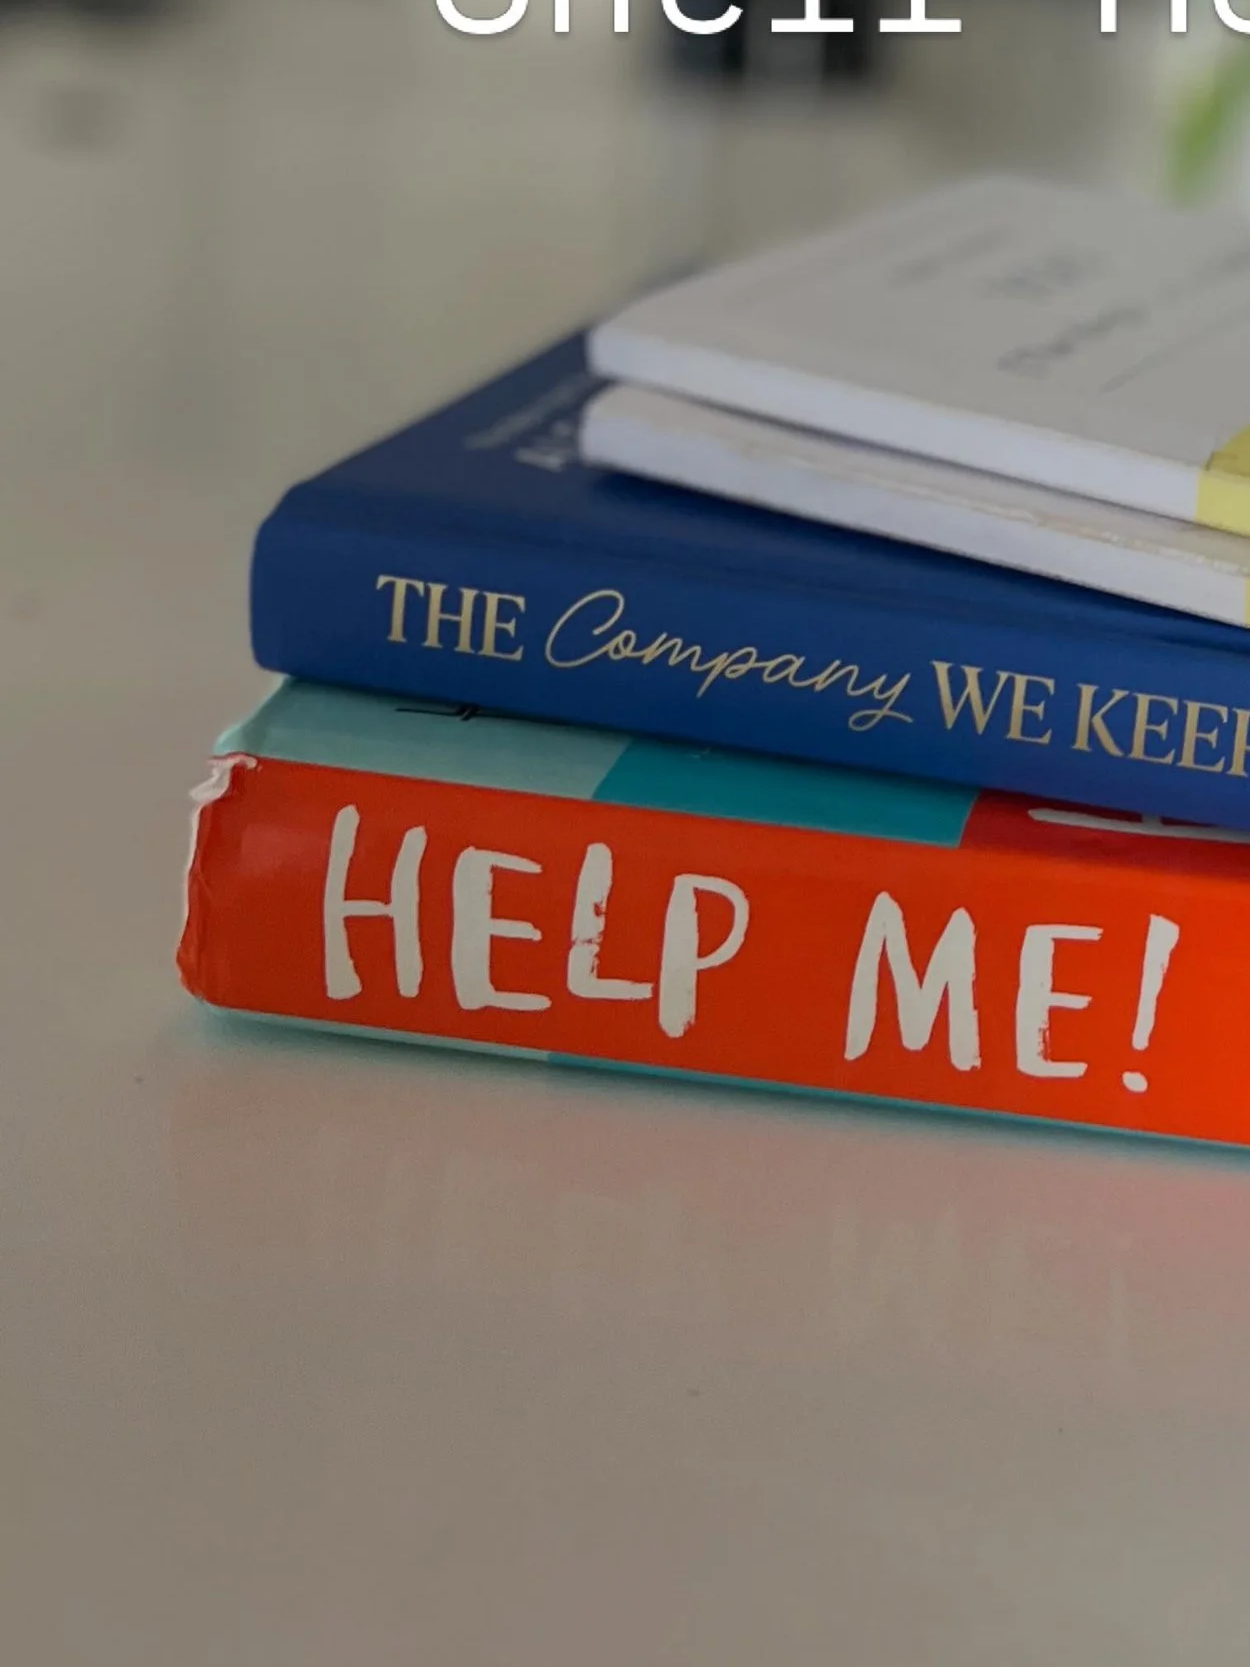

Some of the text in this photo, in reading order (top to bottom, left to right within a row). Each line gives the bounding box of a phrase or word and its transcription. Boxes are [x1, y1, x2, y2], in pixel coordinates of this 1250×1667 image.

[377, 574, 526, 662] THE
[545, 589, 914, 732] Company
[930, 659, 1056, 745] WE
[322, 803, 1181, 1094] HELP ME!
